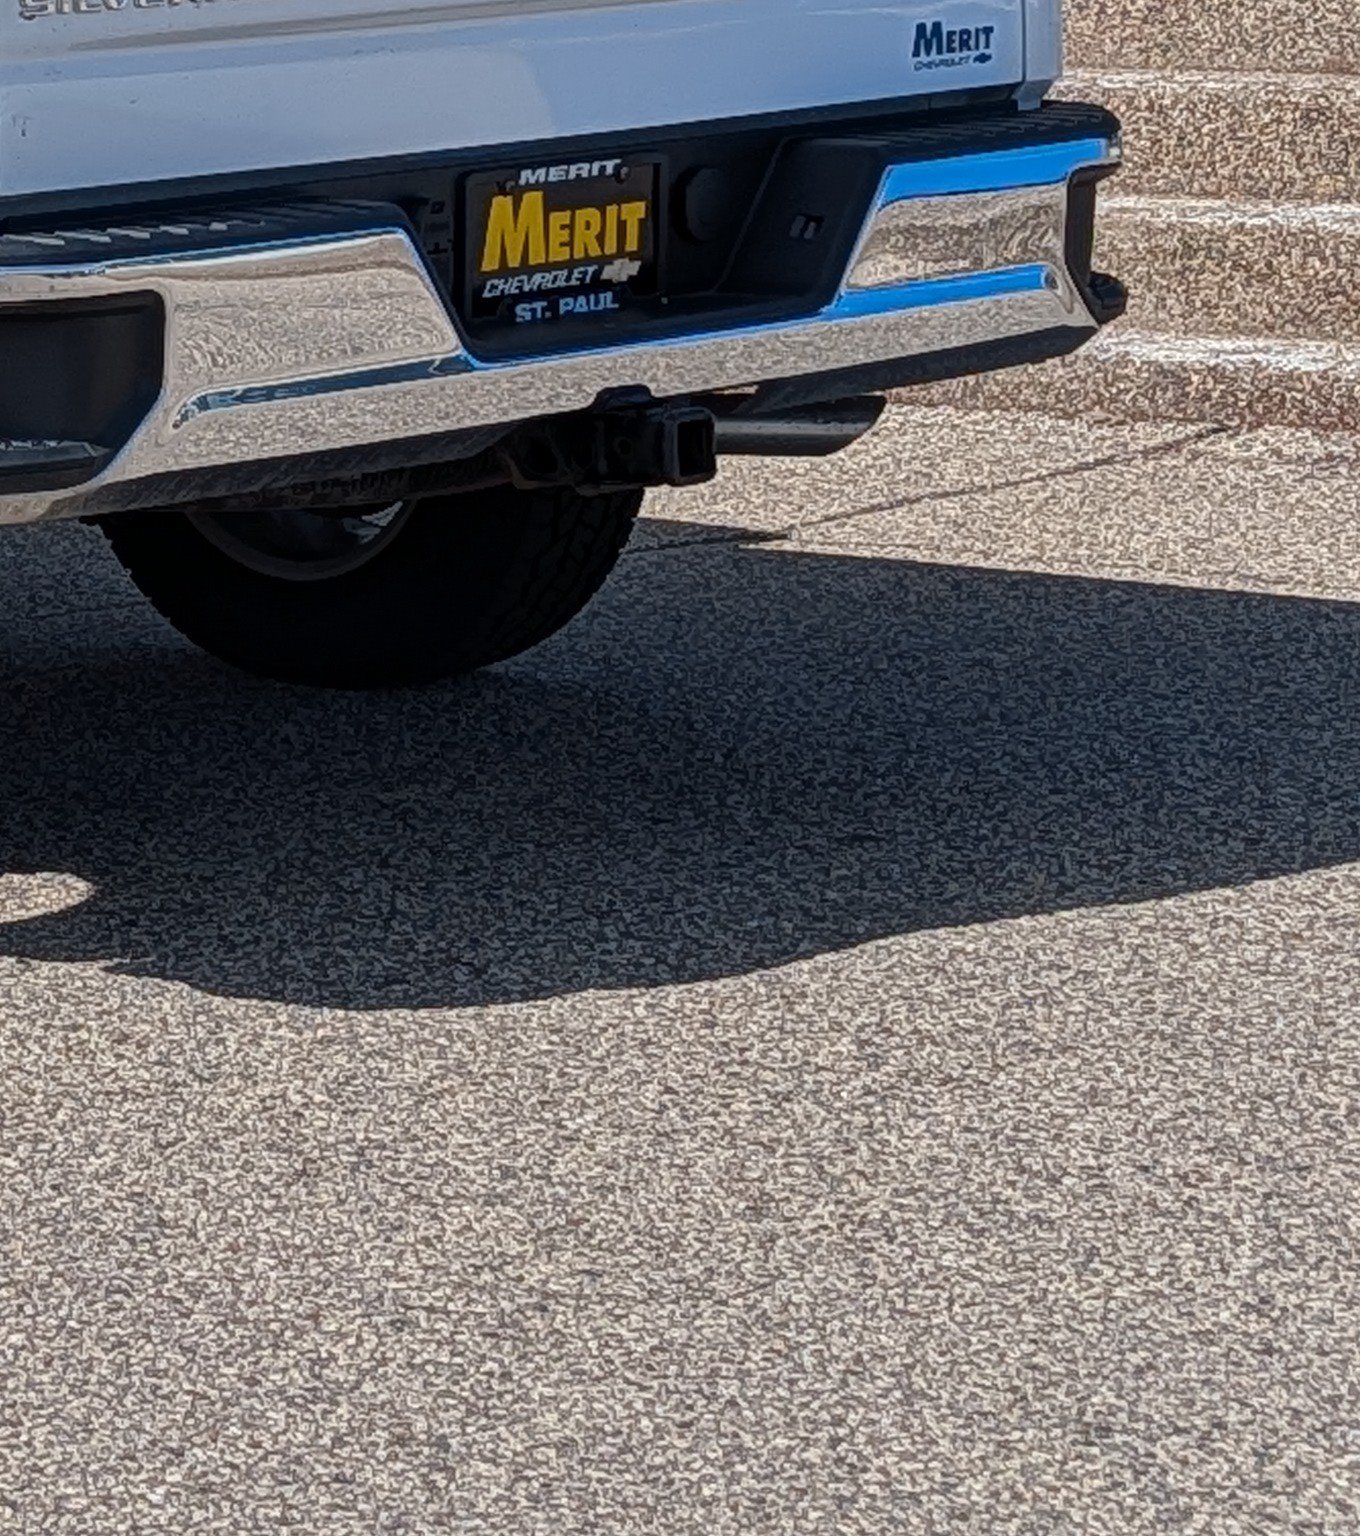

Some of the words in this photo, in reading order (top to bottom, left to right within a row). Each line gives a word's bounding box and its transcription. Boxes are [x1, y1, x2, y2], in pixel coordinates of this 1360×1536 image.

[518, 159, 622, 186] MERIT
[482, 265, 599, 298] CHEVROLET
[515, 301, 552, 322] ST.
[559, 291, 619, 315] PAUL
